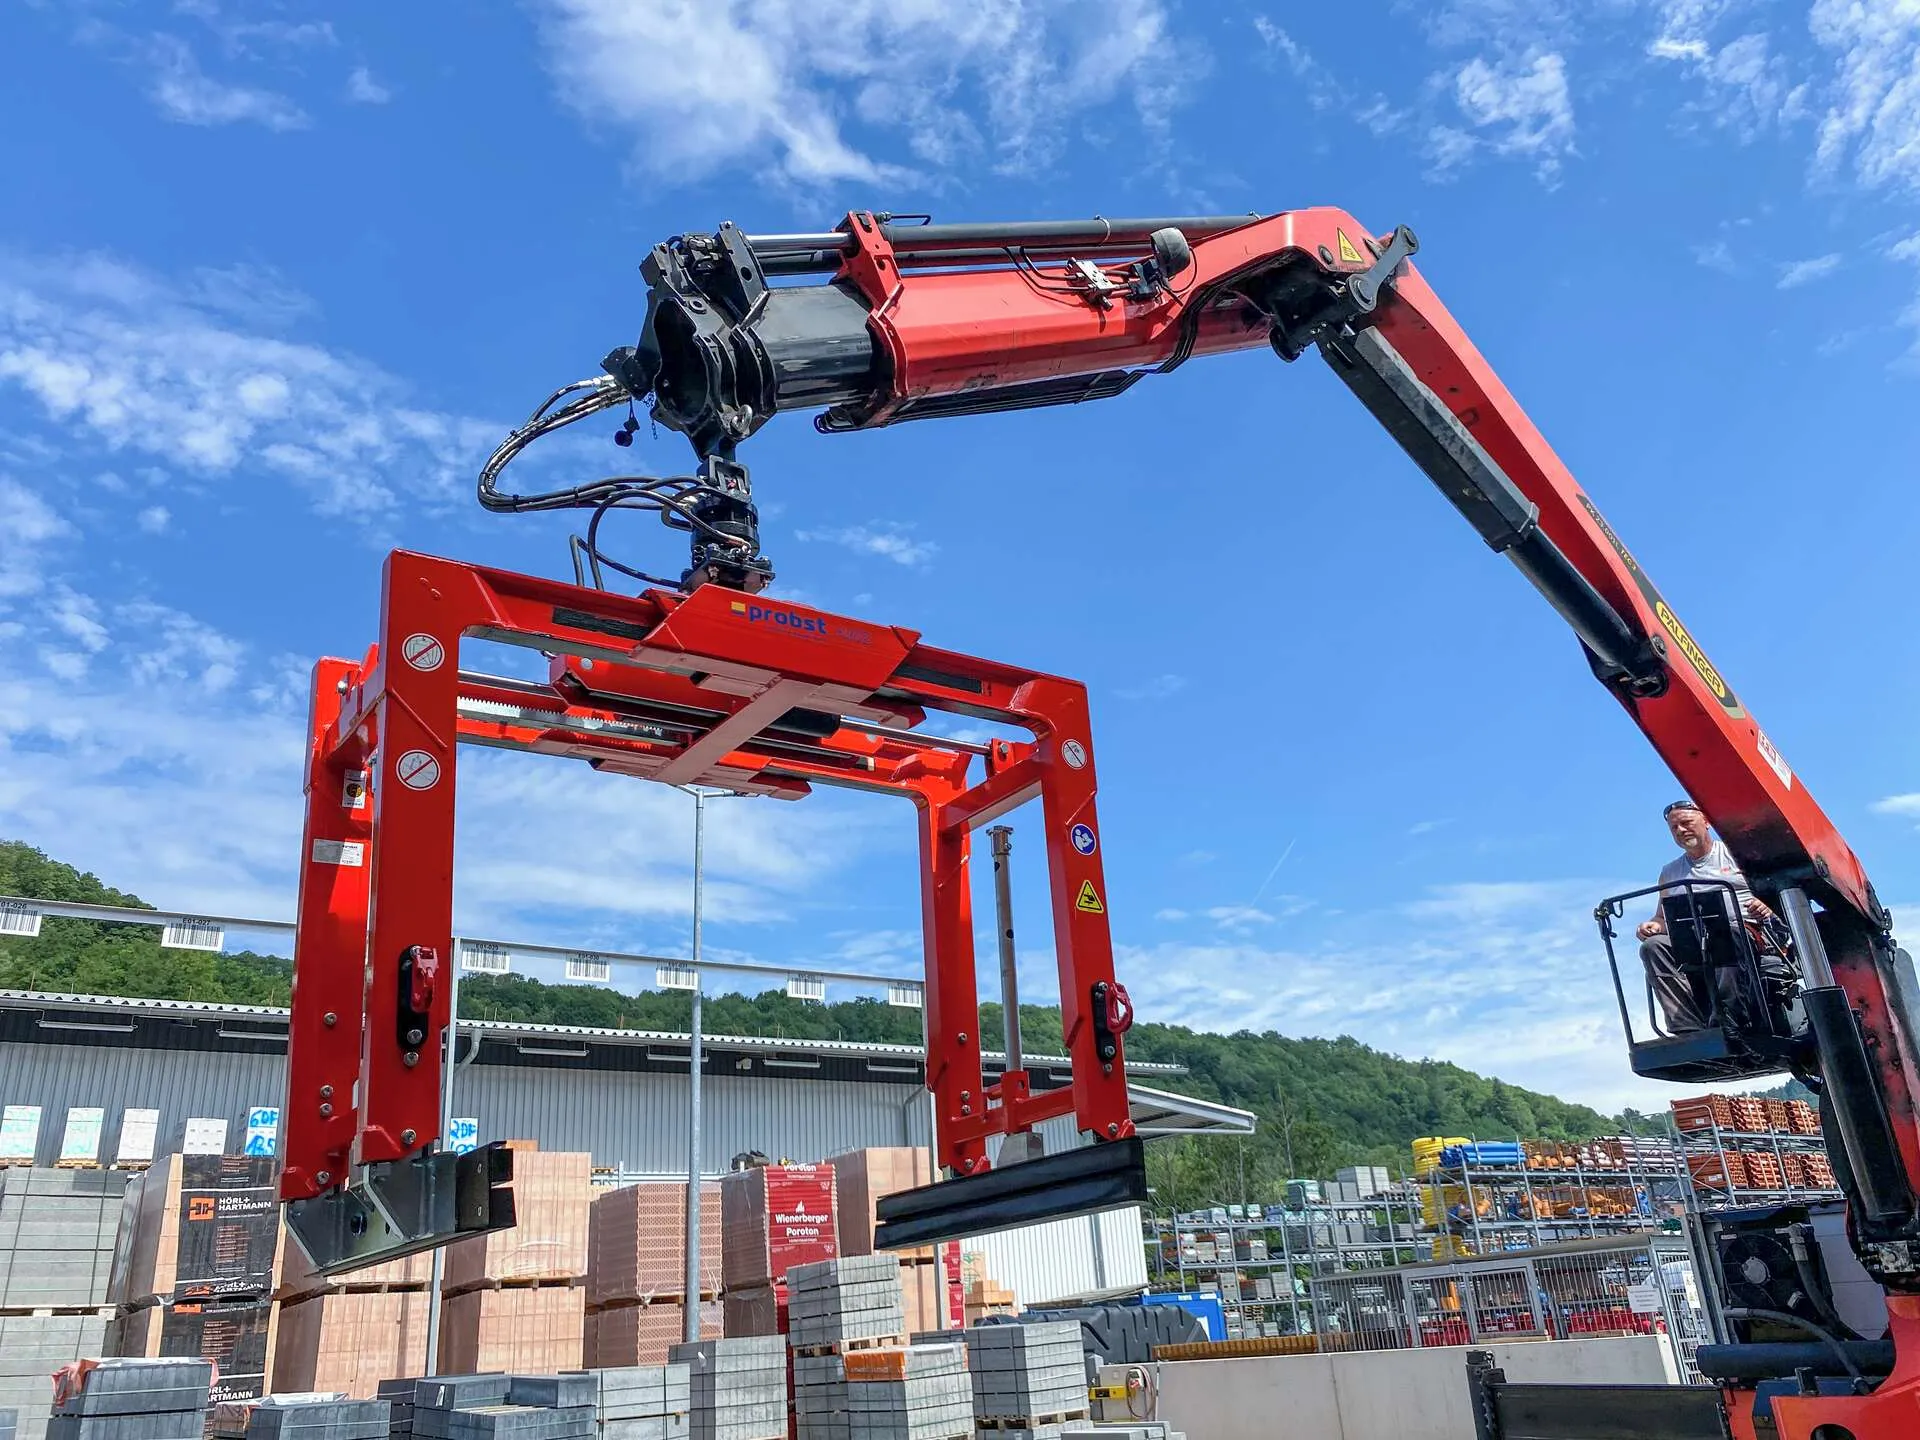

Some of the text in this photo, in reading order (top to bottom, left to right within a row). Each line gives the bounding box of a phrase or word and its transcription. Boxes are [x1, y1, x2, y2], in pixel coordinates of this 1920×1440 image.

[749, 605, 827, 635] probst
[1661, 607, 1721, 694] PALFINGER
[0, 901, 27, 909] 01-026
[182, 917, 210, 926] E01-027
[219, 1196, 251, 1205] HÖRL+
[218, 1201, 272, 1211] HARTMANN
[775, 1213, 829, 1224] Wienerberger
[786, 1227, 819, 1237] Poroton
